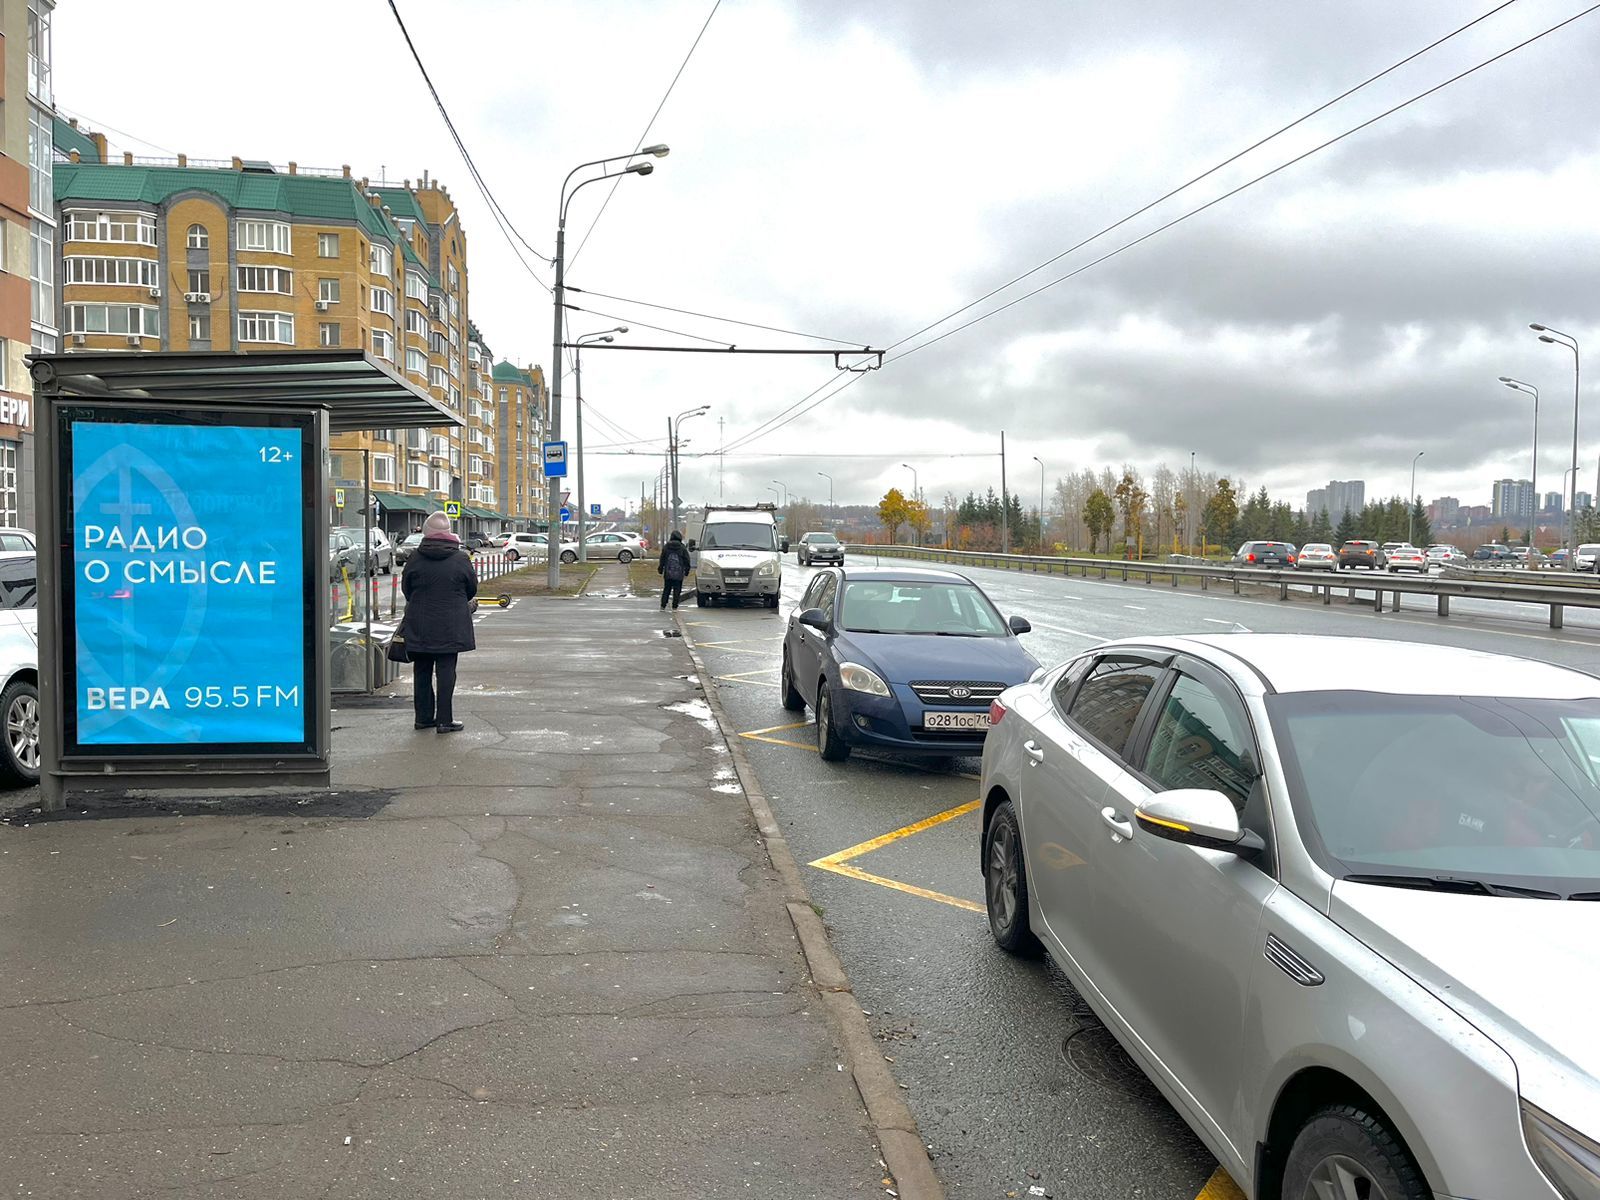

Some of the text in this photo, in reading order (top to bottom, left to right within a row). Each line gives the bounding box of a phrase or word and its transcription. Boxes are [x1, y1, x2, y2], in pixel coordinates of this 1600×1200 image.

[259, 447, 293, 462] 12+
[85, 525, 207, 552] РАДИО
[84, 560, 275, 584] О СМЫСЛЕ
[87, 685, 298, 710] ВЕРА 95.5 FM
